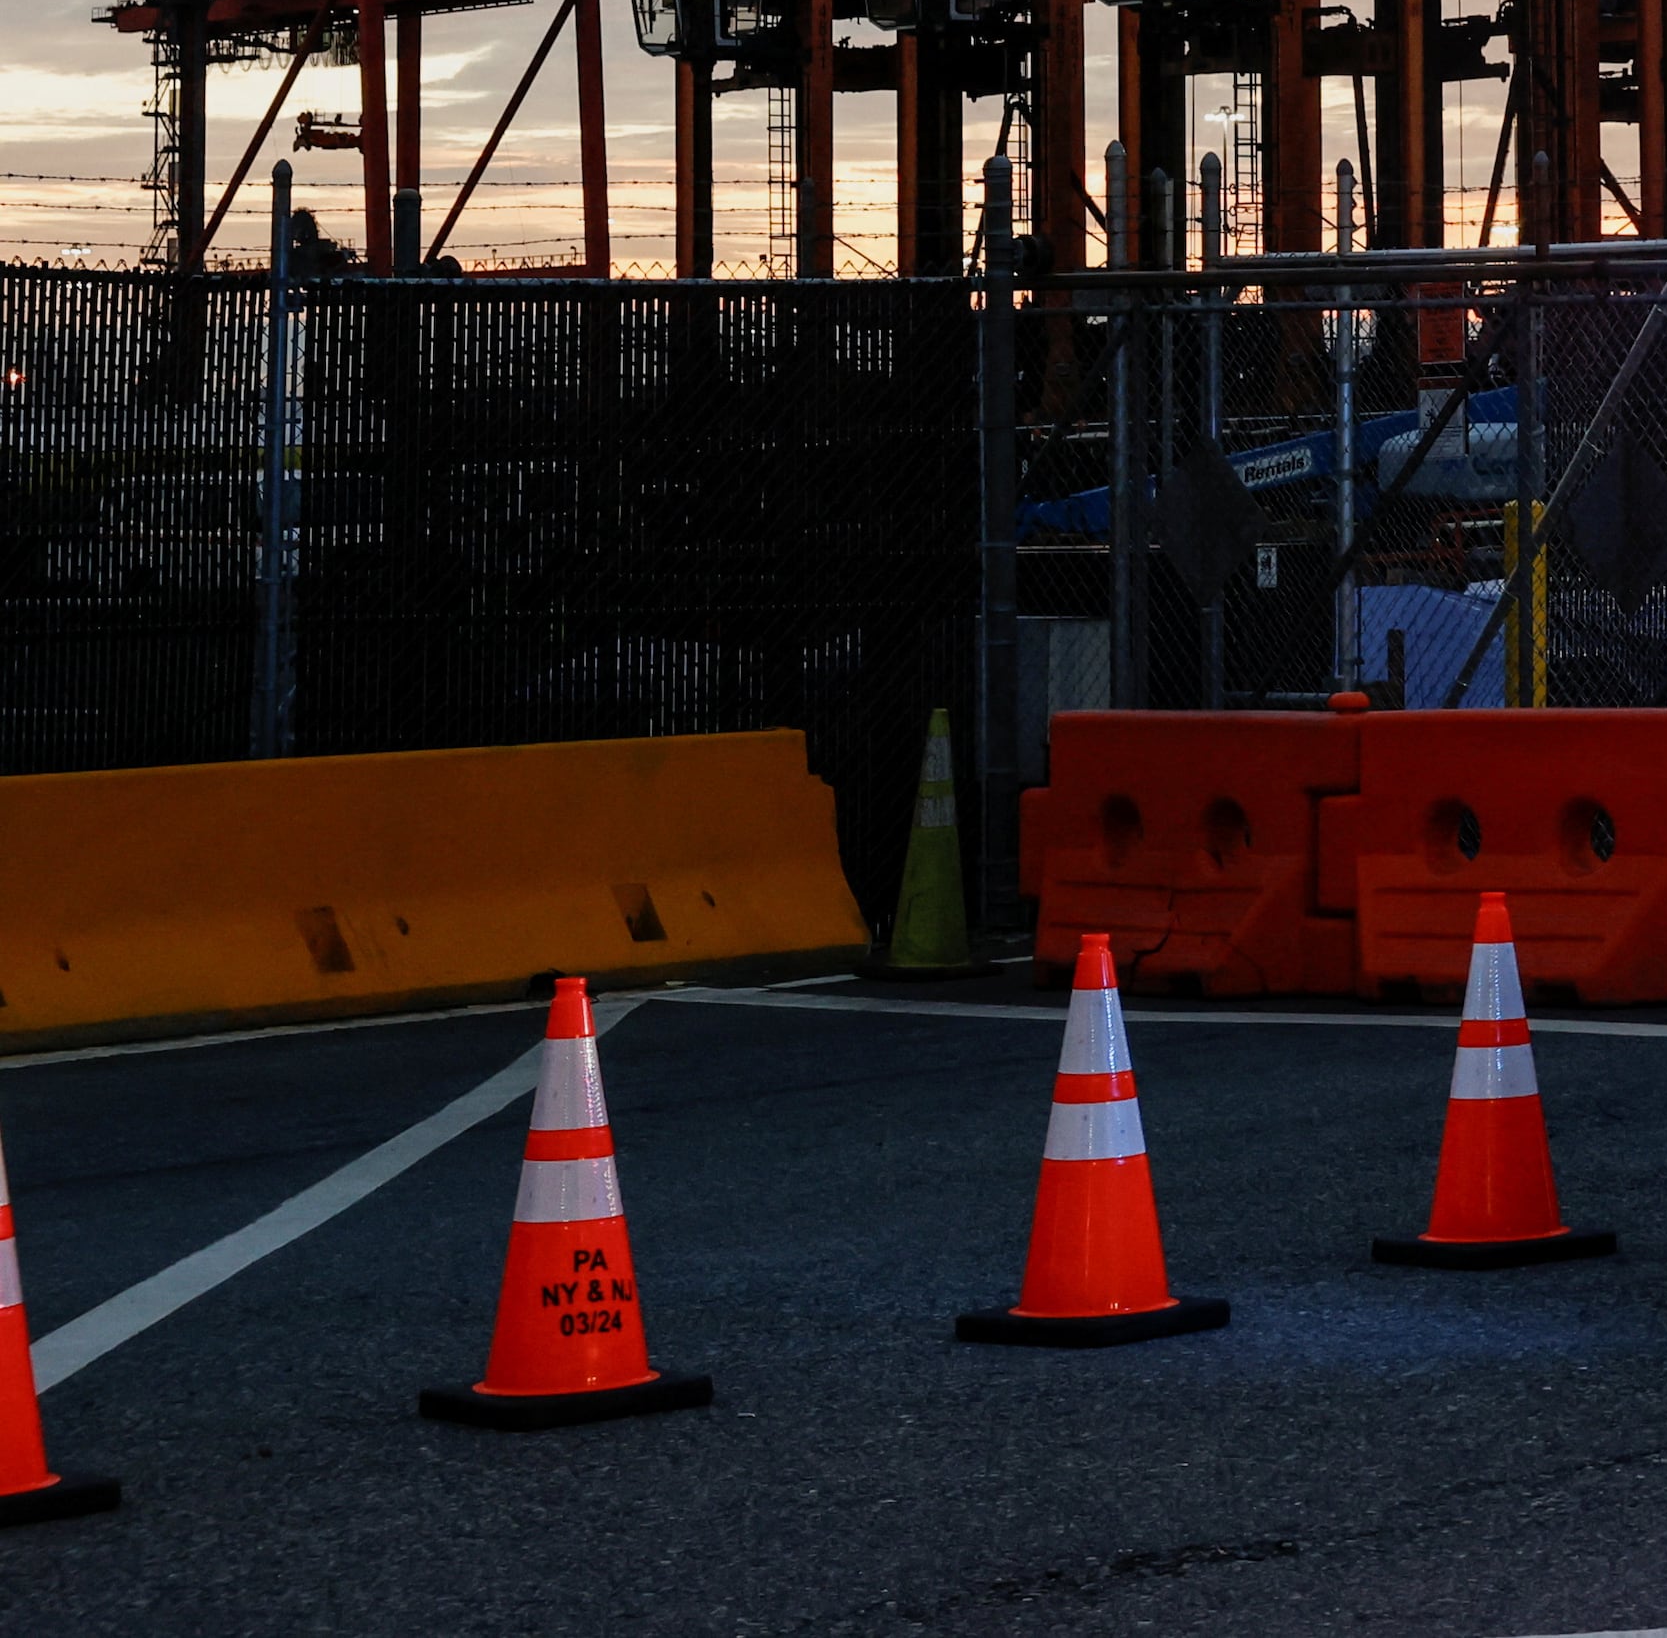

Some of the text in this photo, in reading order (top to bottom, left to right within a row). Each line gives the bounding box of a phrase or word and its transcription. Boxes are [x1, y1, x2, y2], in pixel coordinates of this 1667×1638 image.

[1244, 455, 1305, 483] Rentals
[573, 1249, 609, 1273] PA
[542, 1278, 633, 1309] NY & NJ
[560, 1310, 623, 1337] 03/24
